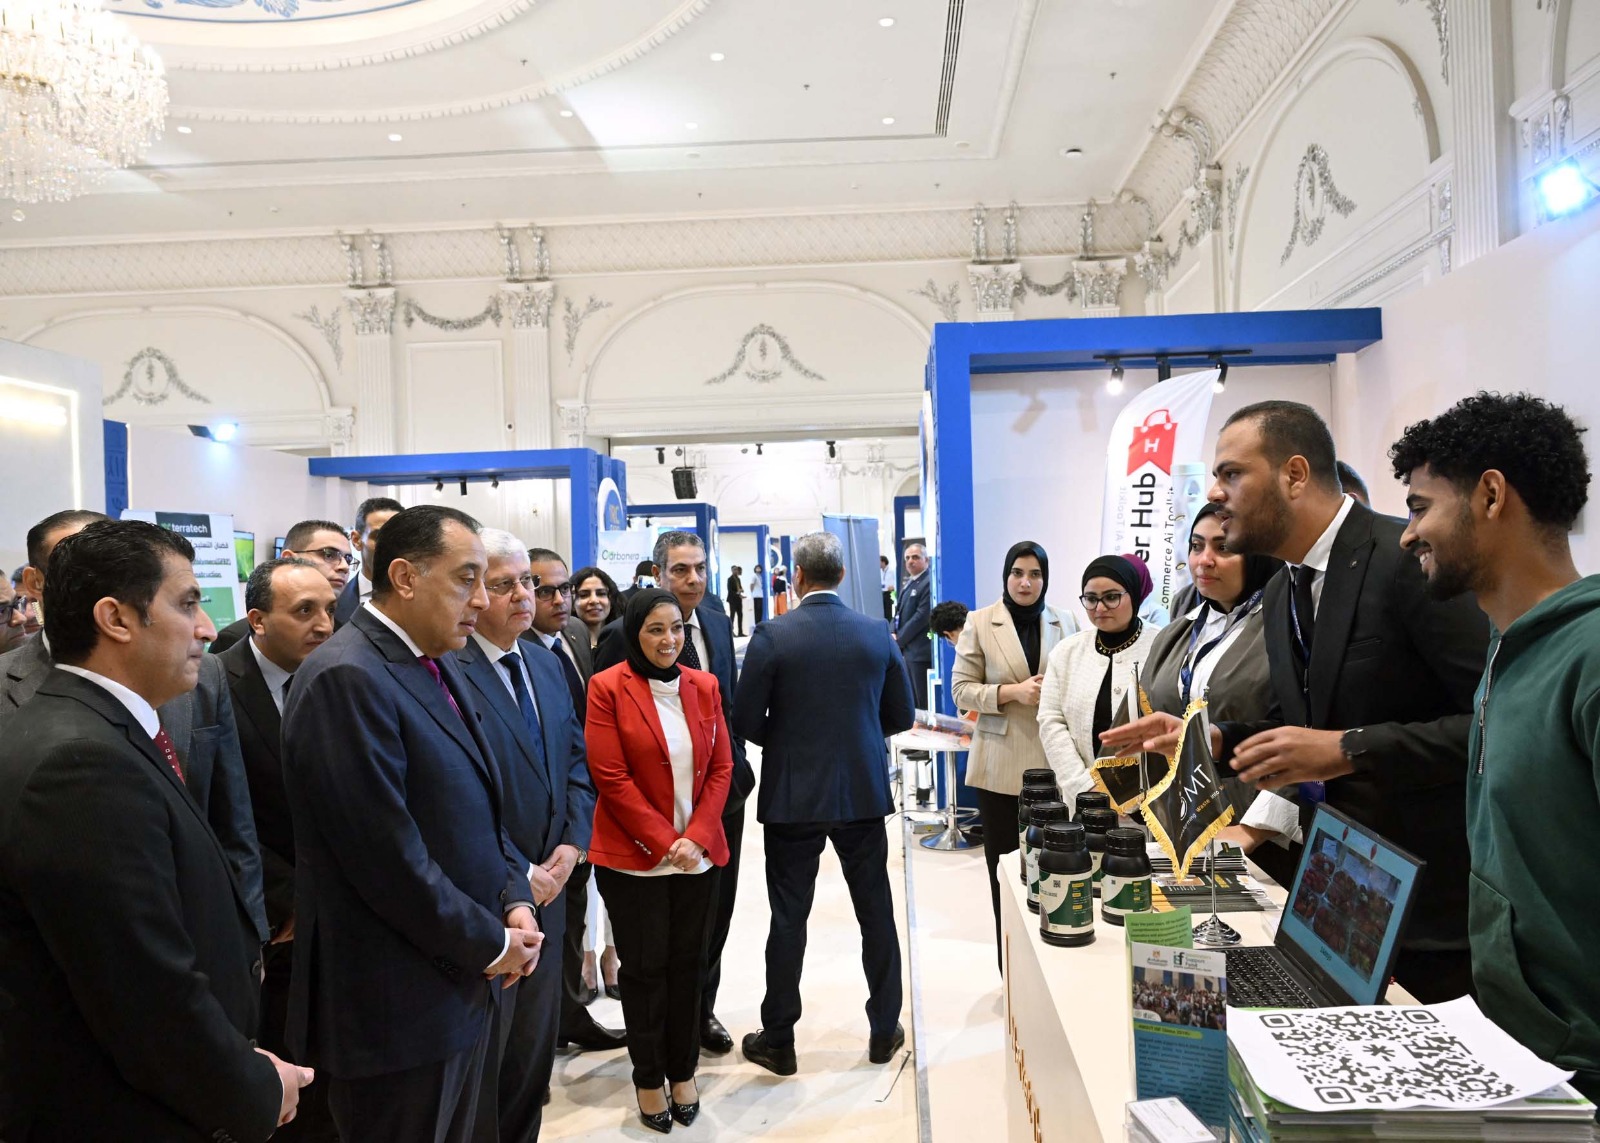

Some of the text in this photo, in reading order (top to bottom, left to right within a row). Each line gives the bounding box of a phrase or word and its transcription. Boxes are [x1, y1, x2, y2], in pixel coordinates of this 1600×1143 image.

[1144, 438, 1159, 453] H
[1130, 472, 1156, 528] Hub
[172, 523, 208, 534] terratech
[602, 549, 639, 561] Carbonera
[1195, 798, 1210, 813] Waste
